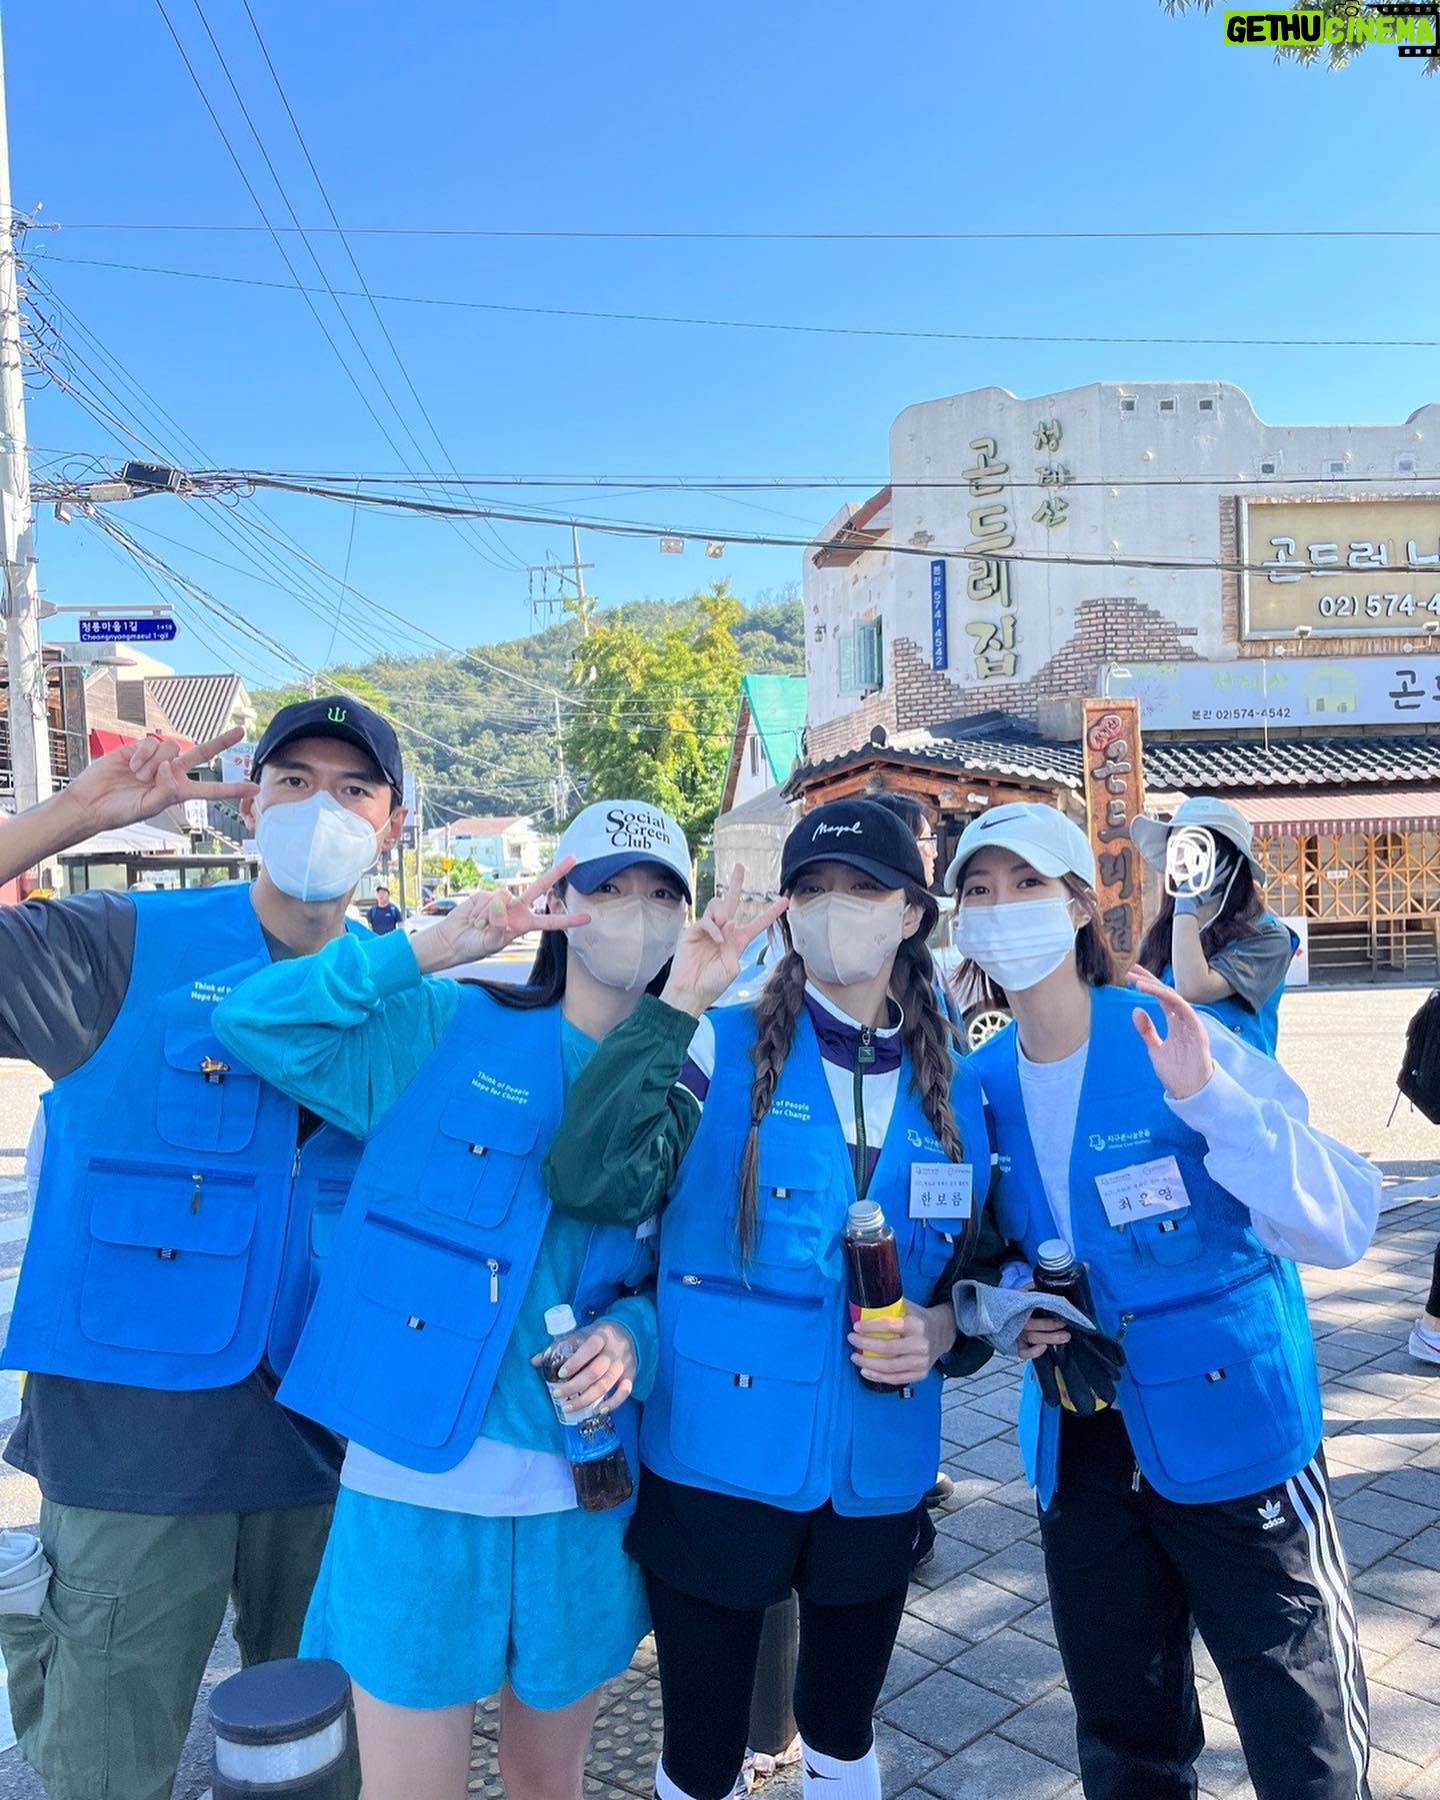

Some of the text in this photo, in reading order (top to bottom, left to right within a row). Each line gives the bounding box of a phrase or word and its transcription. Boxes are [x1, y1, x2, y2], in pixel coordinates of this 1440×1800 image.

[961, 437, 1016, 680] 곤드레집
[605, 808, 666, 834] Social
[611, 831, 652, 849] Club
[625, 822, 671, 845] Green
[194, 981, 216, 992] Think
[191, 991, 211, 1002] Hope
[471, 1078, 528, 1105] Hope for Change
[478, 1071, 496, 1086] Think
[505, 1084, 529, 1096] People
[783, 1109, 811, 1121] Change
[784, 1101, 809, 1111] People
[1262, 1516, 1286, 1530] adidas
